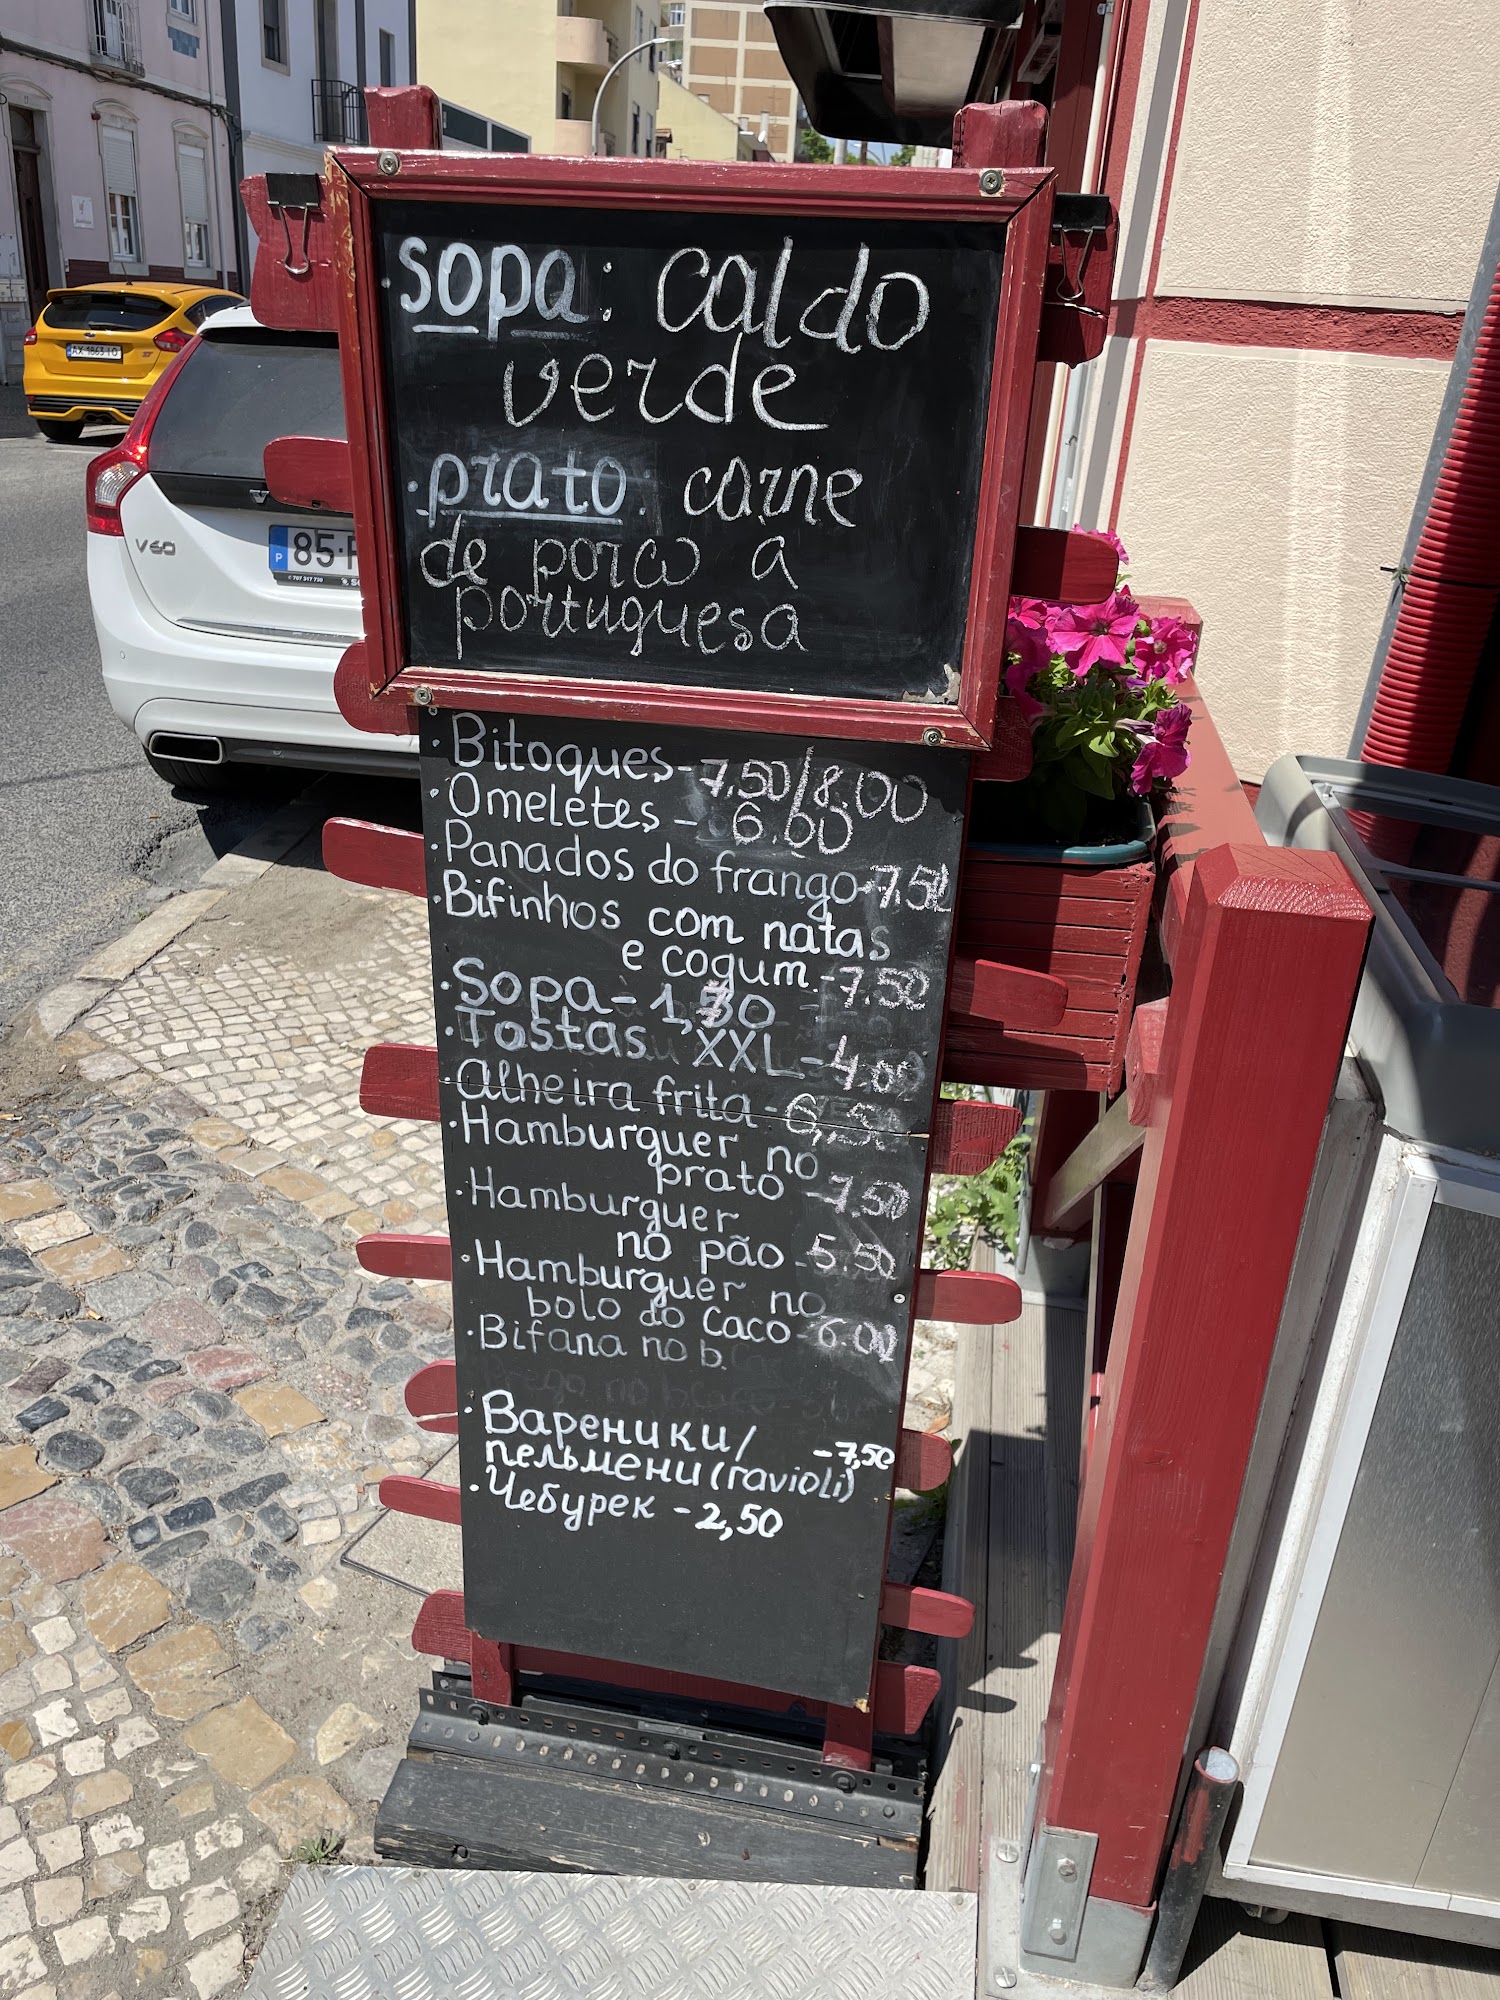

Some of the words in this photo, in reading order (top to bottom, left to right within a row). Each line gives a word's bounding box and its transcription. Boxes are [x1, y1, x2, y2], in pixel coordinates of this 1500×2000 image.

[656, 236, 930, 355] caldo
[72, 345, 84, 356] AX
[502, 332, 830, 431] verde
[683, 456, 864, 528] carne
[135, 538, 176, 556] V60
[419, 513, 489, 588] de
[456, 585, 809, 661] portuguesa
[450, 711, 676, 794] Bitoques
[448, 771, 661, 833] Omeletes
[444, 818, 635, 883] Panados
[647, 841, 699, 887] do
[443, 869, 622, 931] Bifinhos
[648, 905, 744, 946] com
[762, 911, 891, 962] natas
[621, 938, 644, 970] e
[454, 1005, 647, 1058] Tostas
[692, 1028, 806, 1080] XXL
[456, 1058, 641, 1114] Alheira
[652, 1074, 759, 1129] frita
[461, 1101, 739, 1168] Hamburguer
[765, 1144, 819, 1181] no
[470, 1165, 740, 1234] Hamburguer
[654, 1159, 785, 1200] prato
[474, 1238, 747, 1309] Hamburguer
[770, 1290, 827, 1319] no
[616, 1228, 672, 1262] no
[699, 1234, 785, 1275] pão
[478, 1312, 628, 1356] Bifana
[642, 1330, 688, 1363] no
[526, 1285, 621, 1322] bolo
[485, 1464, 656, 1532] Чебурек
